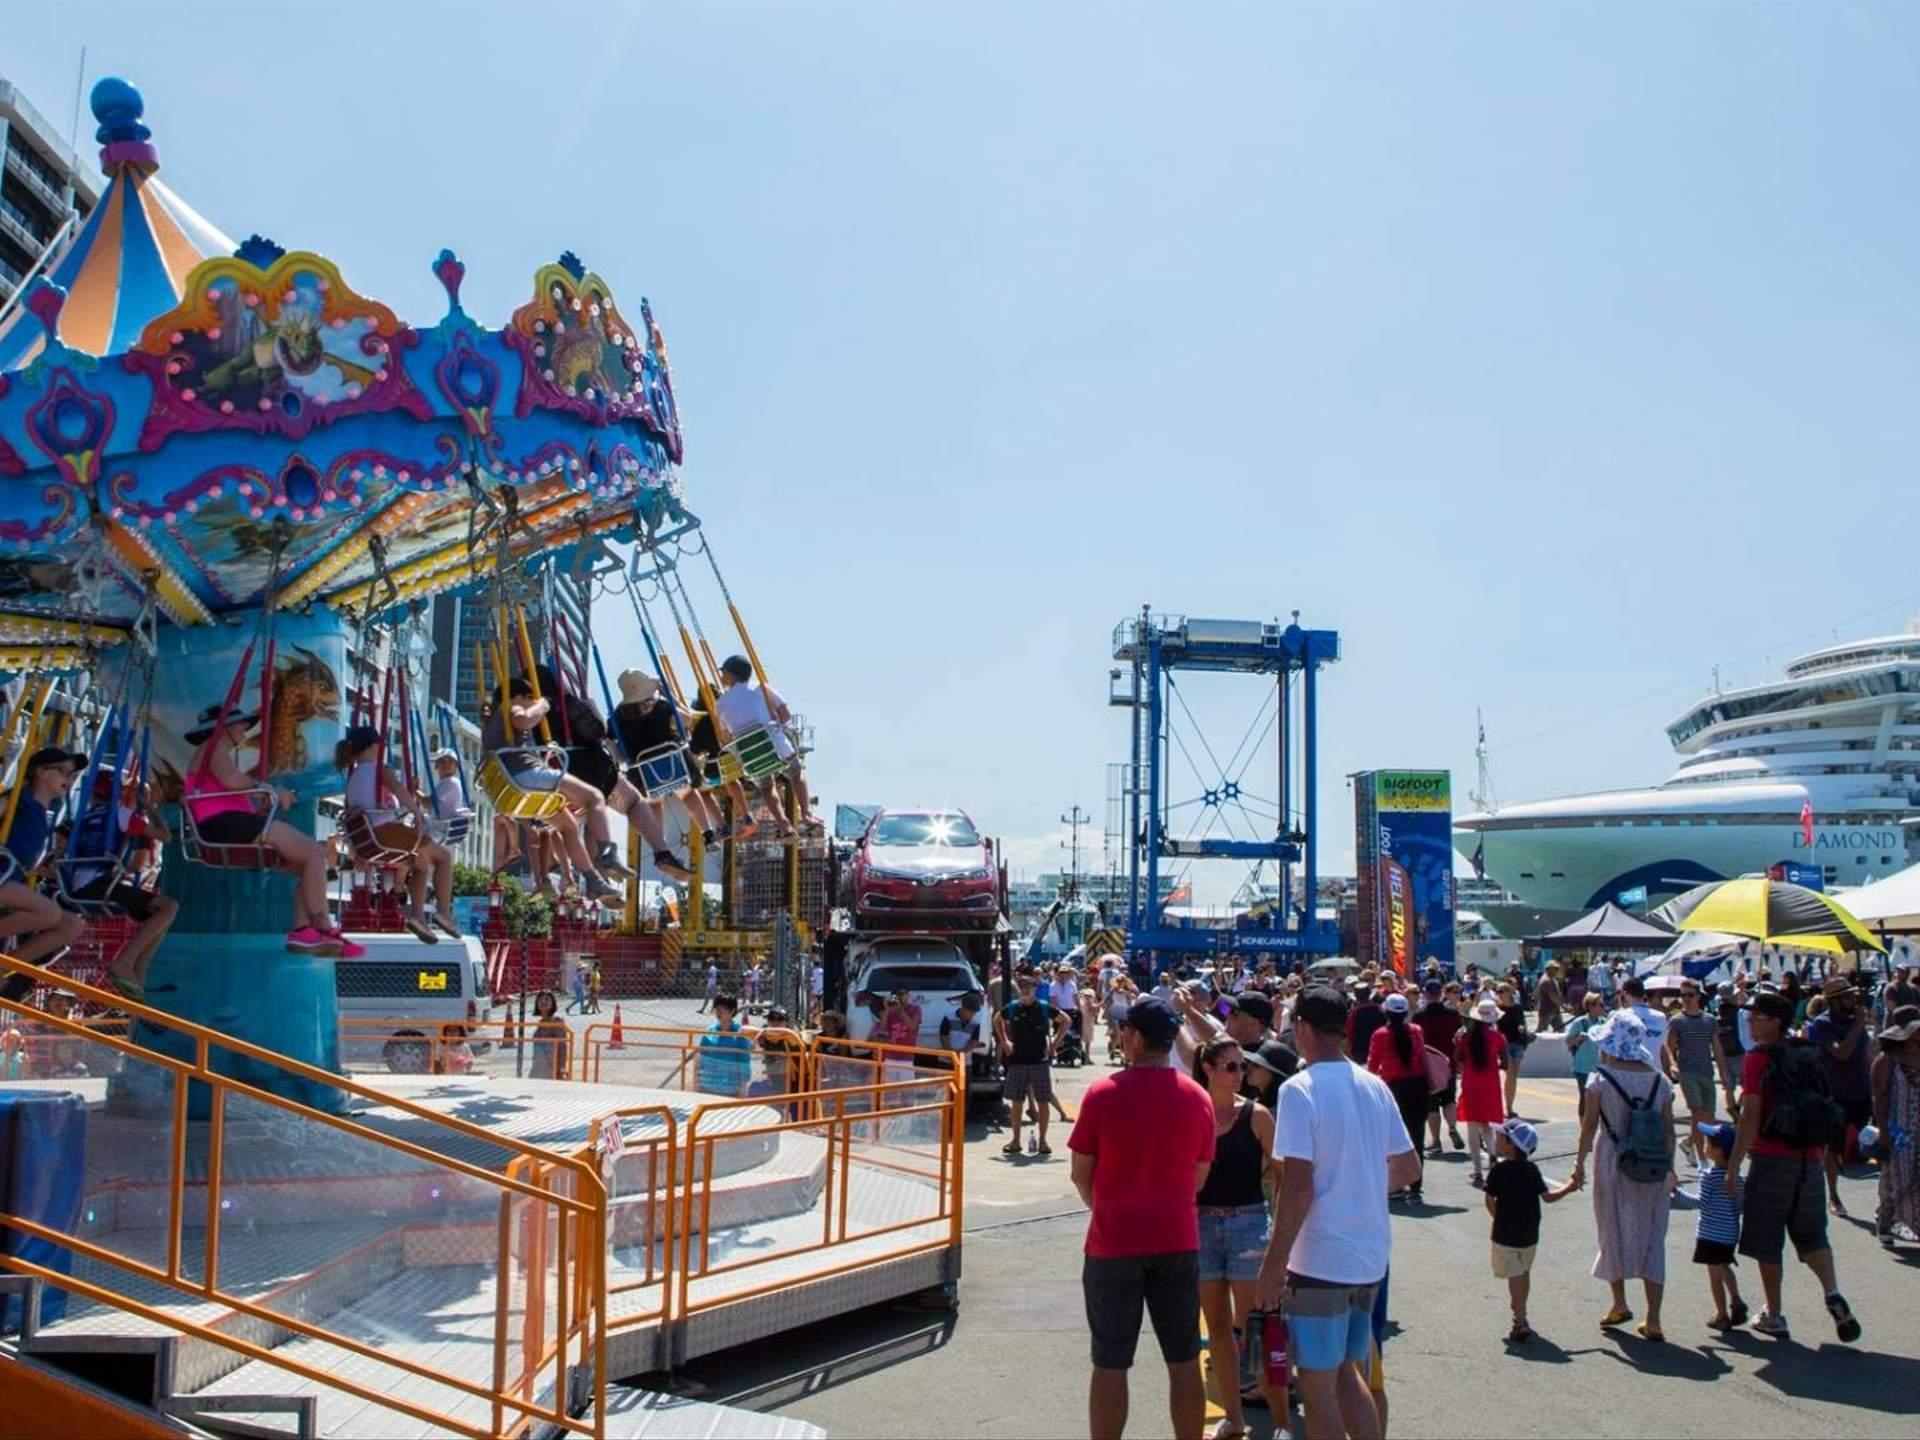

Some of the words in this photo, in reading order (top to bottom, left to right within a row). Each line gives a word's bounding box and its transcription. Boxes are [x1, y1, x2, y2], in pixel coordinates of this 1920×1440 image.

[1384, 778, 1443, 790] BIGFOOT
[1380, 824, 1392, 857] FOOT
[1792, 831, 1897, 849] DAMOND
